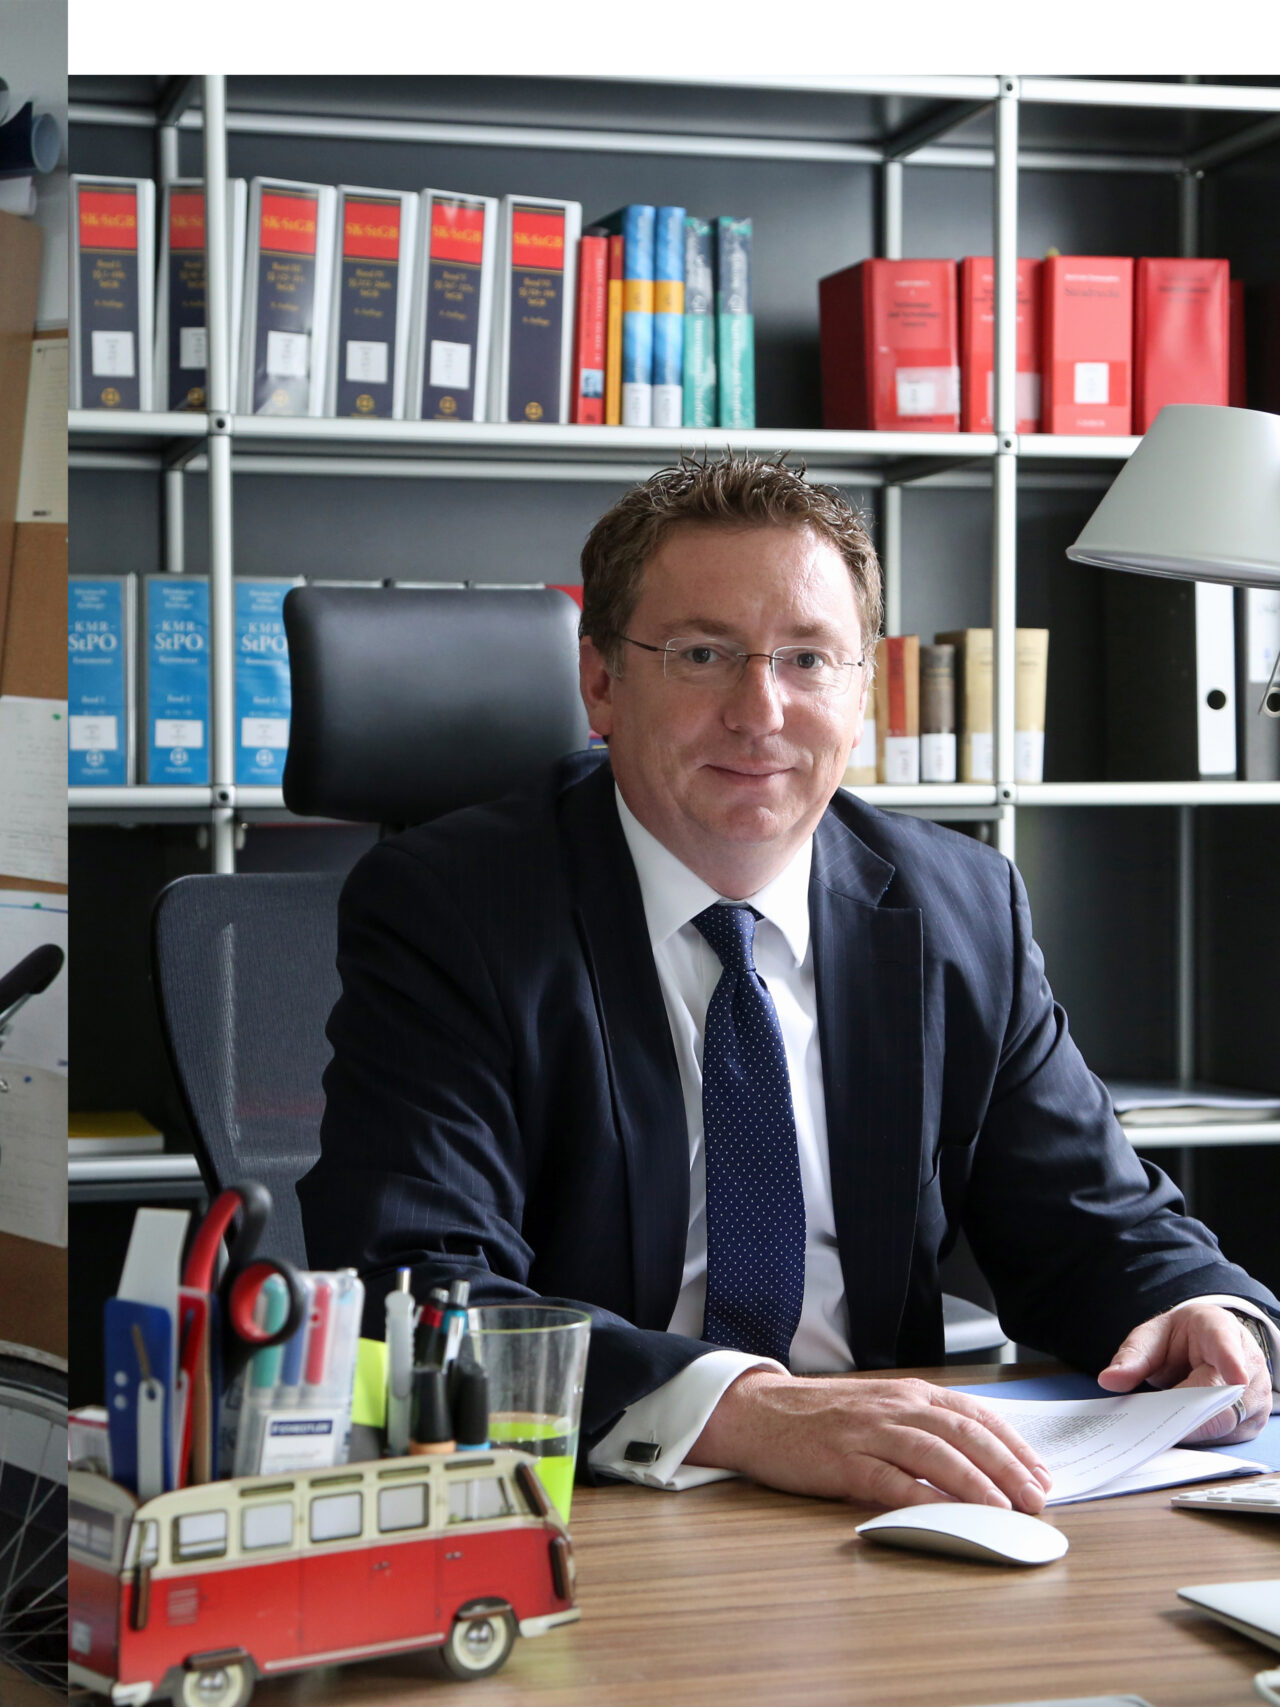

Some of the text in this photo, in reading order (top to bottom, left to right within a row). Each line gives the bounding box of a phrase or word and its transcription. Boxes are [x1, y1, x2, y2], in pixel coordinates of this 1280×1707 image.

[68, 633, 118, 651] StPO
[154, 633, 204, 651] StPO
[241, 634, 288, 652] StPO
